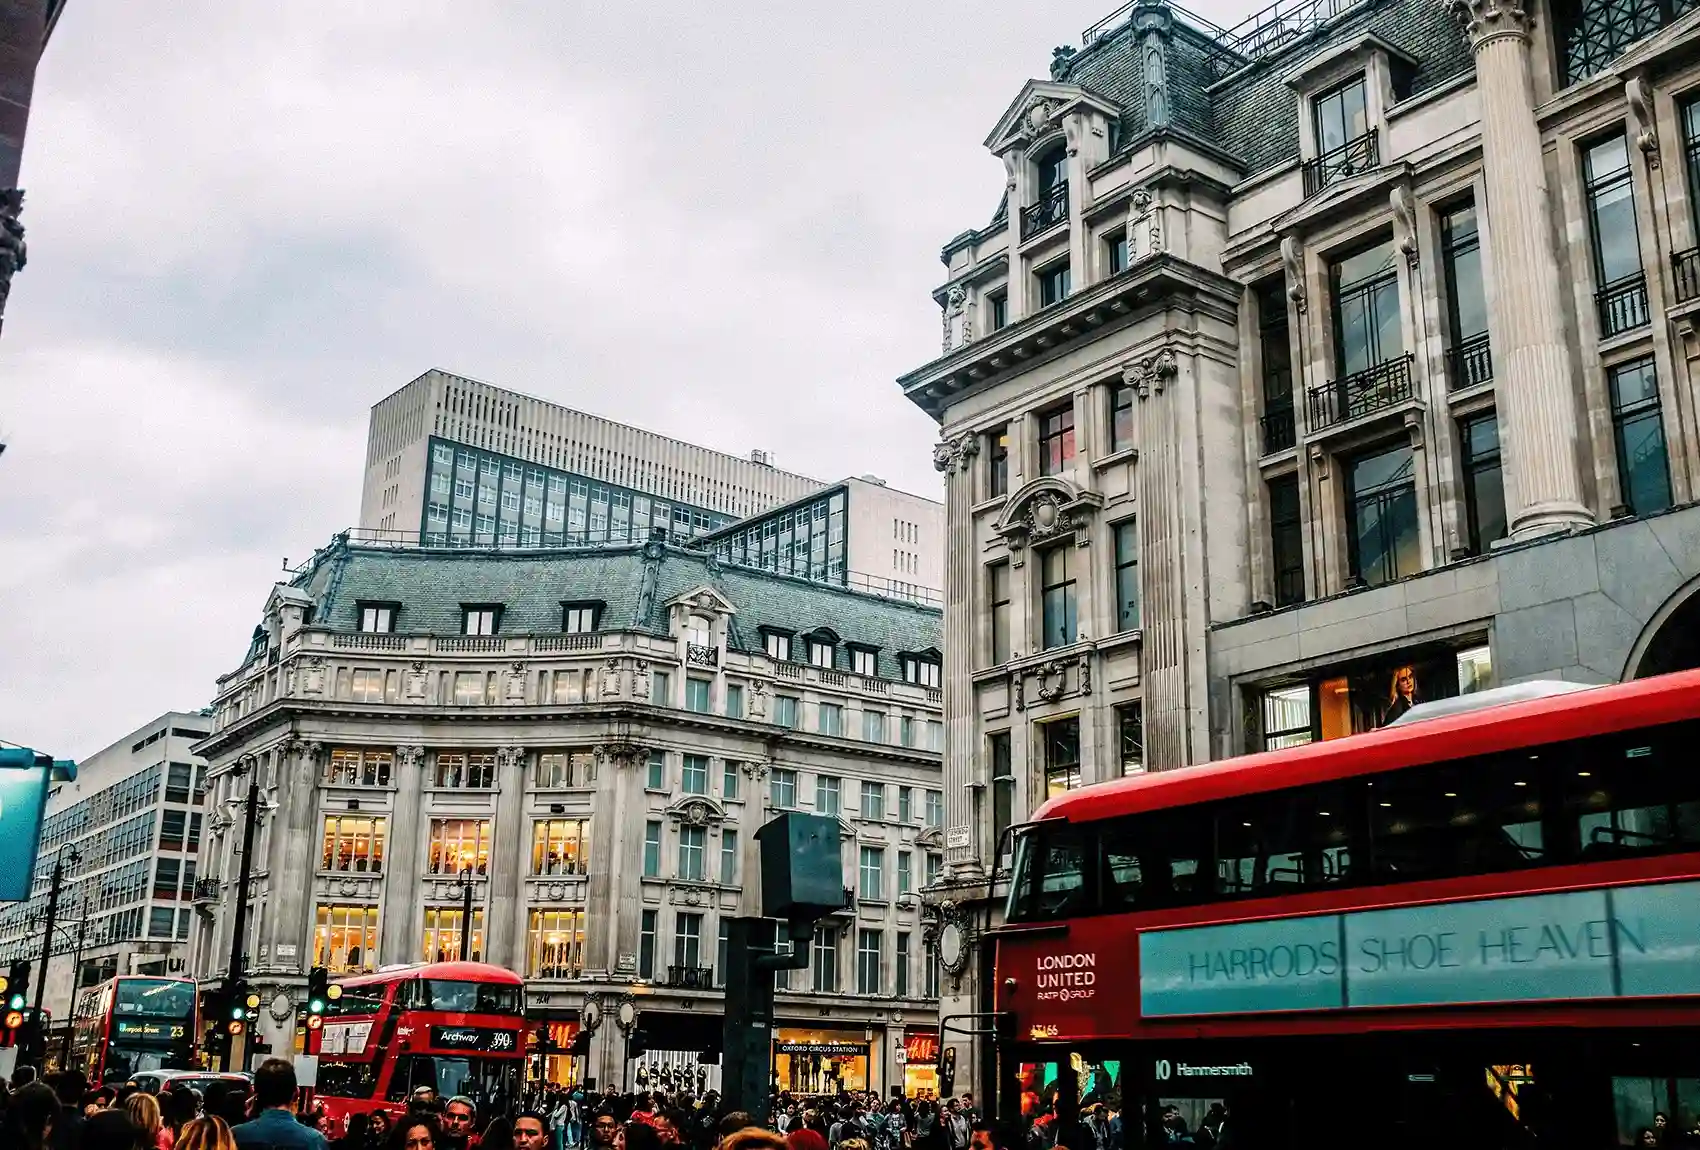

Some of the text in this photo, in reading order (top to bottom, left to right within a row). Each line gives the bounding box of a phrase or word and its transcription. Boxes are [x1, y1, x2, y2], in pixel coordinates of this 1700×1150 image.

[1189, 917, 1647, 982] HARRODS SHOE HEAVEN
[1037, 953, 1096, 970] LONDON
[1037, 971, 1096, 988] UNITED
[1037, 989, 1095, 1000] RATP GROUP
[170, 1026, 184, 1038] 23
[440, 1031, 510, 1048] Archway 390
[808, 1045, 832, 1053] CIRCUS
[832, 1046, 859, 1054] STATION
[907, 1036, 933, 1060] H&M
[1155, 1059, 1253, 1080] 10 Hammersmith
